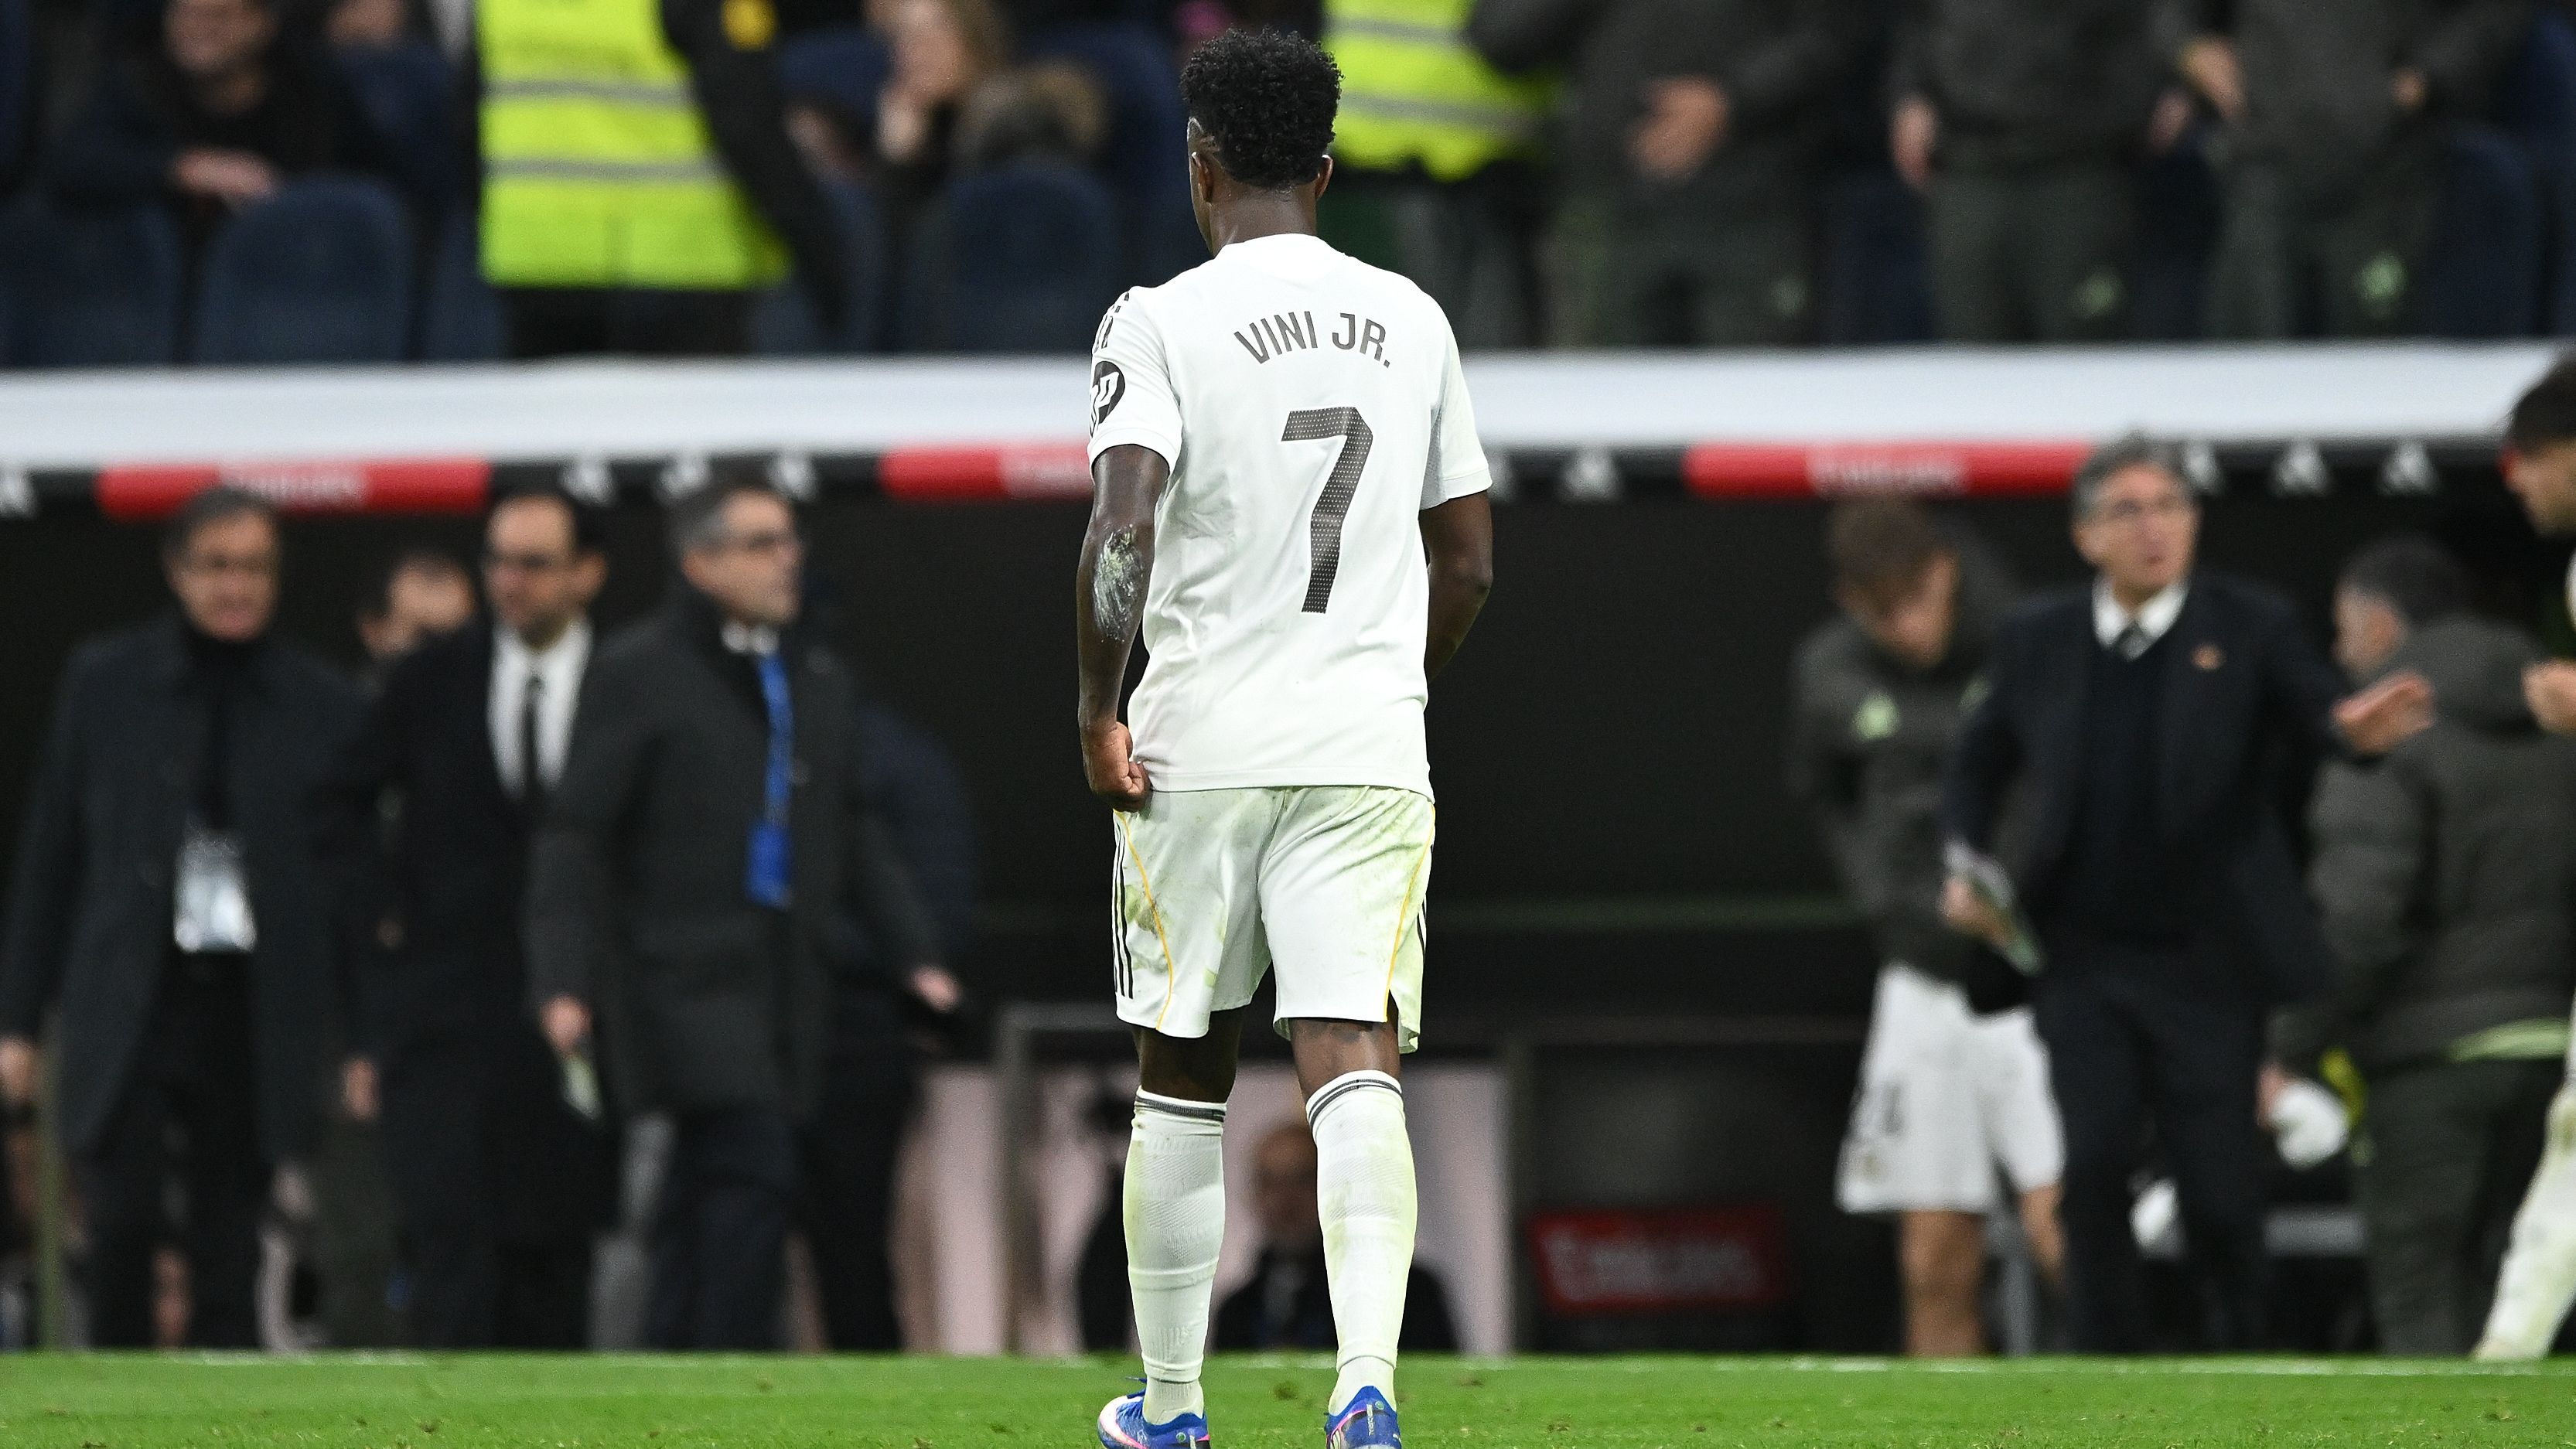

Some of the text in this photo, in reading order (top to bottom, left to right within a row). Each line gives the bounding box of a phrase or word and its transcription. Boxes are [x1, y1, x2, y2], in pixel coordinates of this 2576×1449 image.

[1233, 311, 1390, 368] VINI JR.
[1281, 406, 1373, 614] 7
